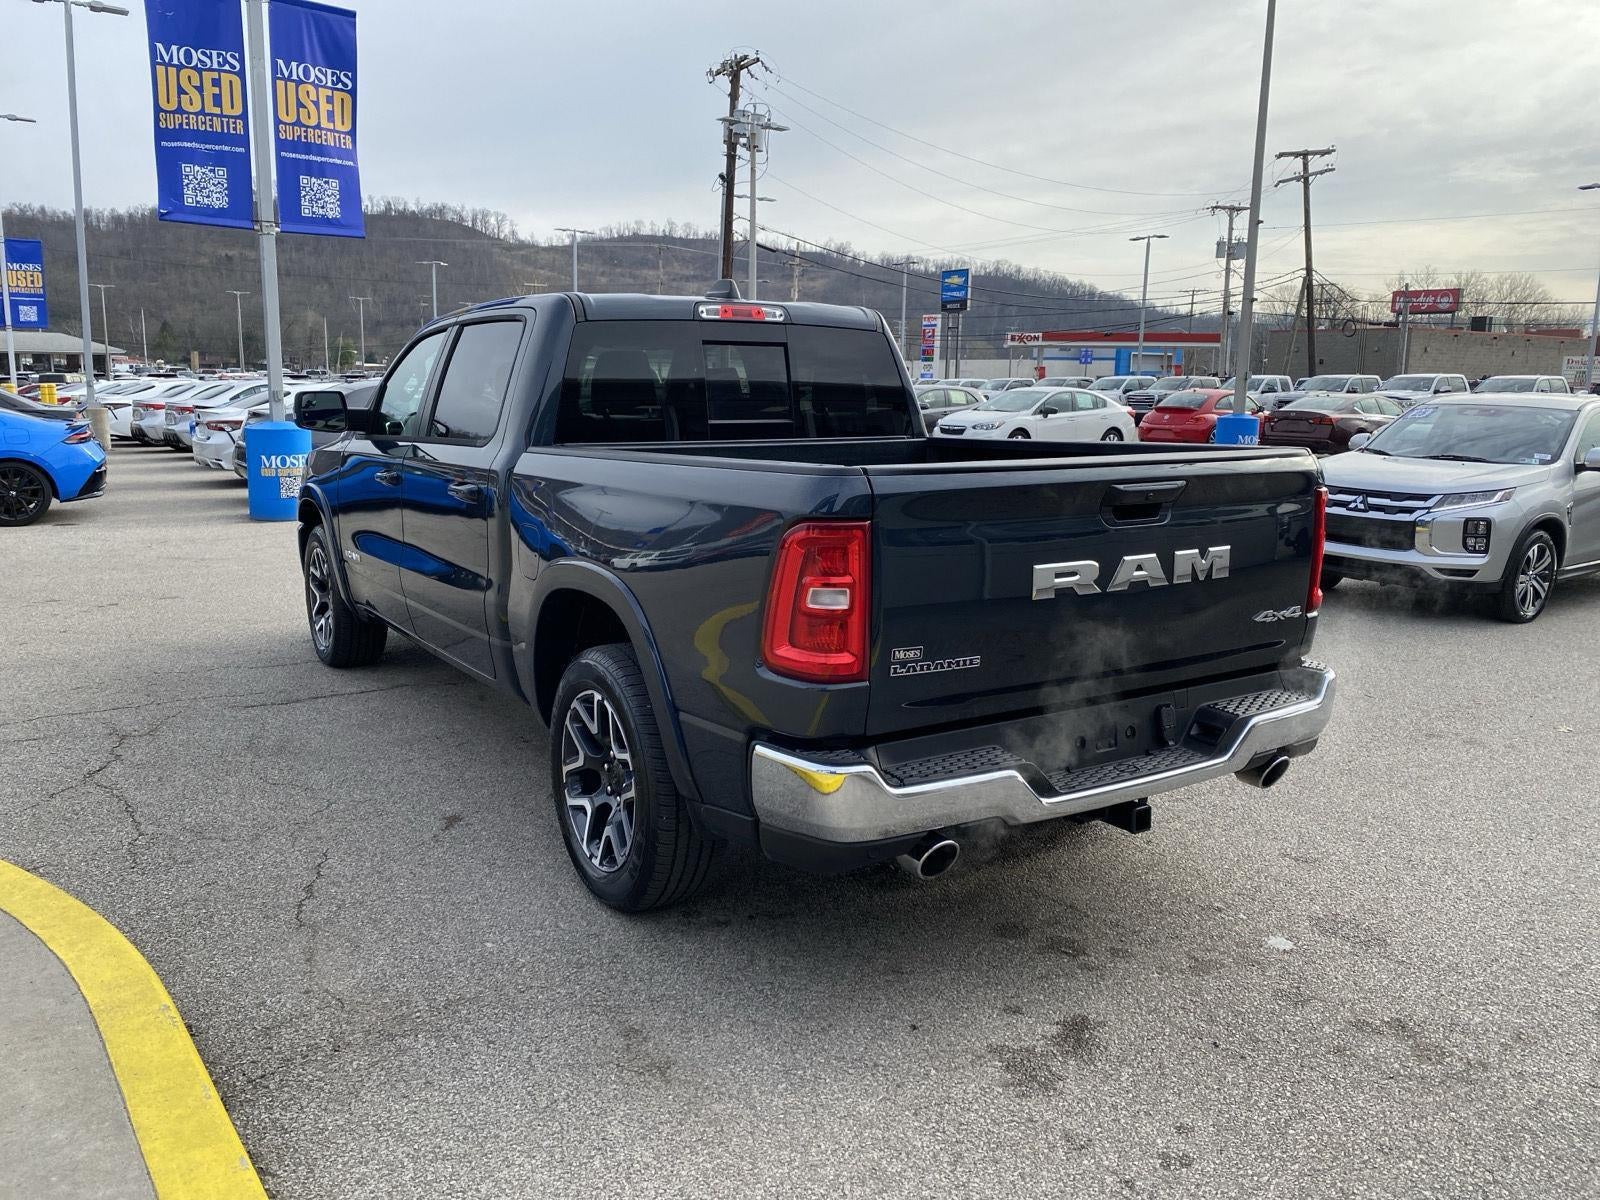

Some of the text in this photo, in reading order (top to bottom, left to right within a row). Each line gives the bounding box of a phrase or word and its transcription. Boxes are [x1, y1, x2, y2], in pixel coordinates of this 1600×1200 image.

[154, 42, 241, 72] MOSES
[275, 58, 352, 90] MOSES
[156, 65, 243, 116] USED
[276, 80, 352, 132] USED
[159, 113, 244, 135] SUPERCENTER
[161, 141, 245, 153] mosesusedsupercenter.com
[279, 124, 352, 150] SUPERCENTER
[281, 151, 353, 166] mosesusedsupercenter.com
[7, 263, 41, 271] MOSES
[7, 270, 43, 288] USED
[1010, 332, 1040, 345] EXXON
[260, 454, 307, 469] MOSE
[1032, 545, 1231, 601] RAM
[1252, 605, 1302, 623] 4x4
[890, 655, 981, 677] LARAMIE
